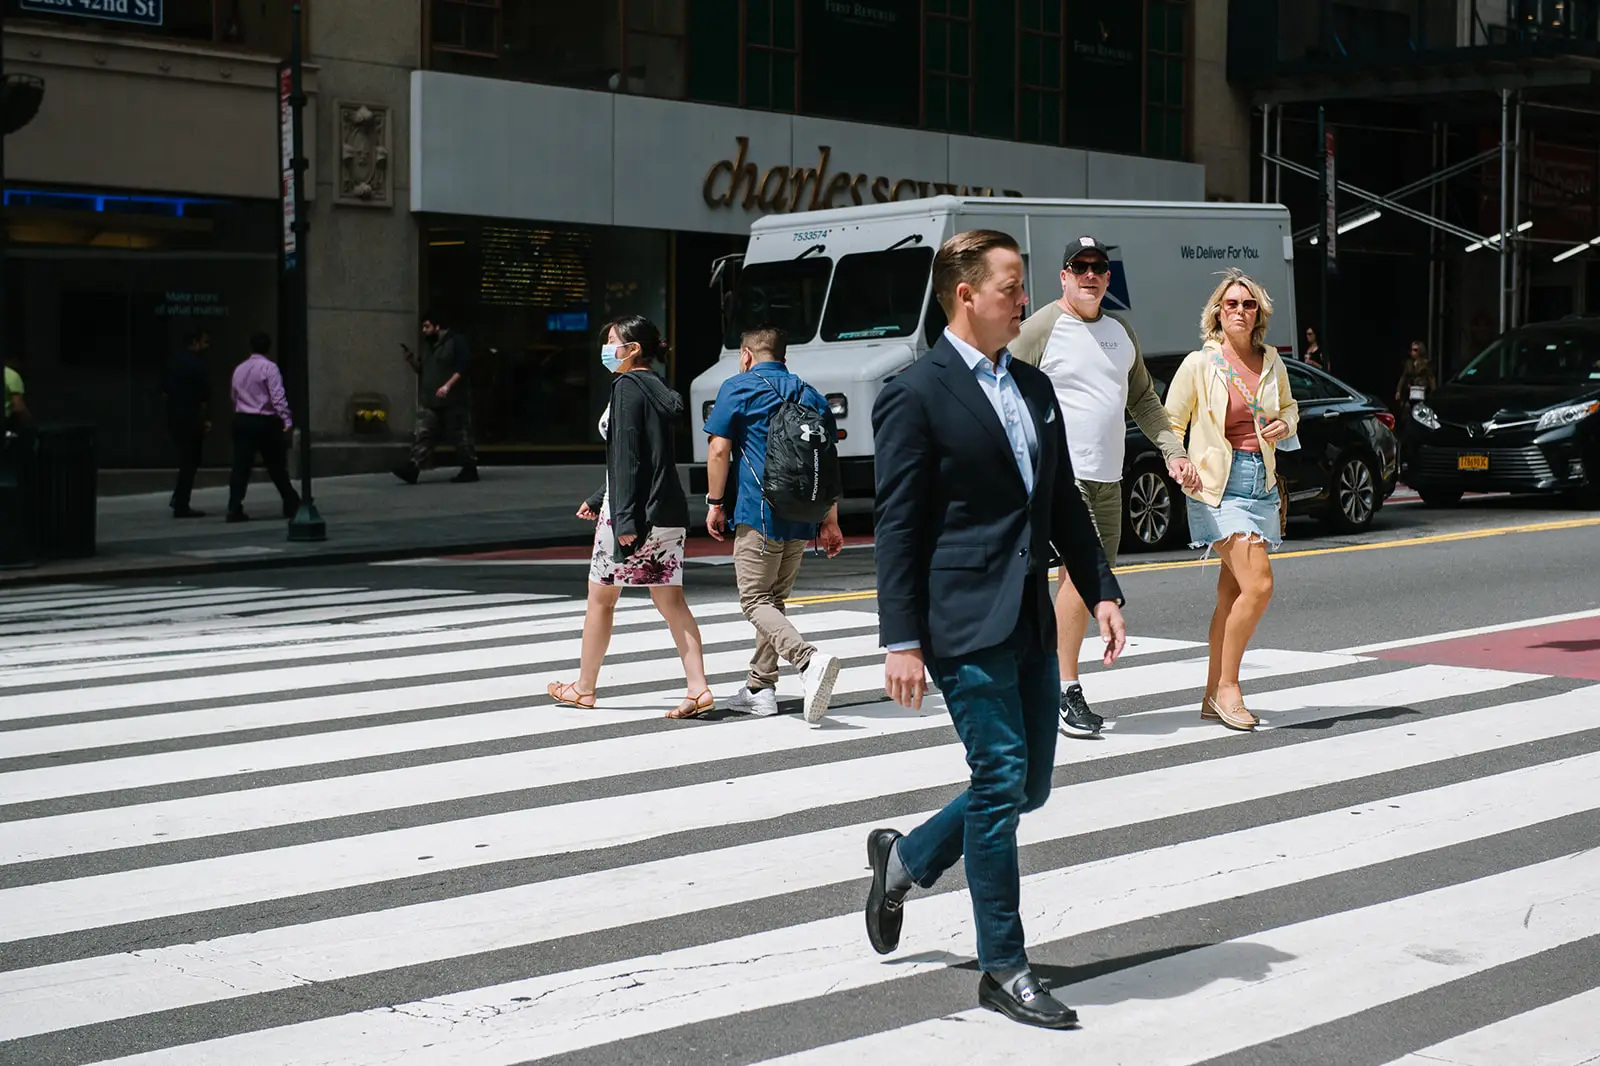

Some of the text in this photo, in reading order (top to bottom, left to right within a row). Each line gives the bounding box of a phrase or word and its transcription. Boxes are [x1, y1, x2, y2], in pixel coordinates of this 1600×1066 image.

[135, 0, 155, 16] St
[703, 136, 868, 213] charles
[793, 230, 827, 242] 7533574
[1180, 245, 1195, 259] We
[1196, 245, 1226, 259] Deliver
[1227, 245, 1242, 259] For
